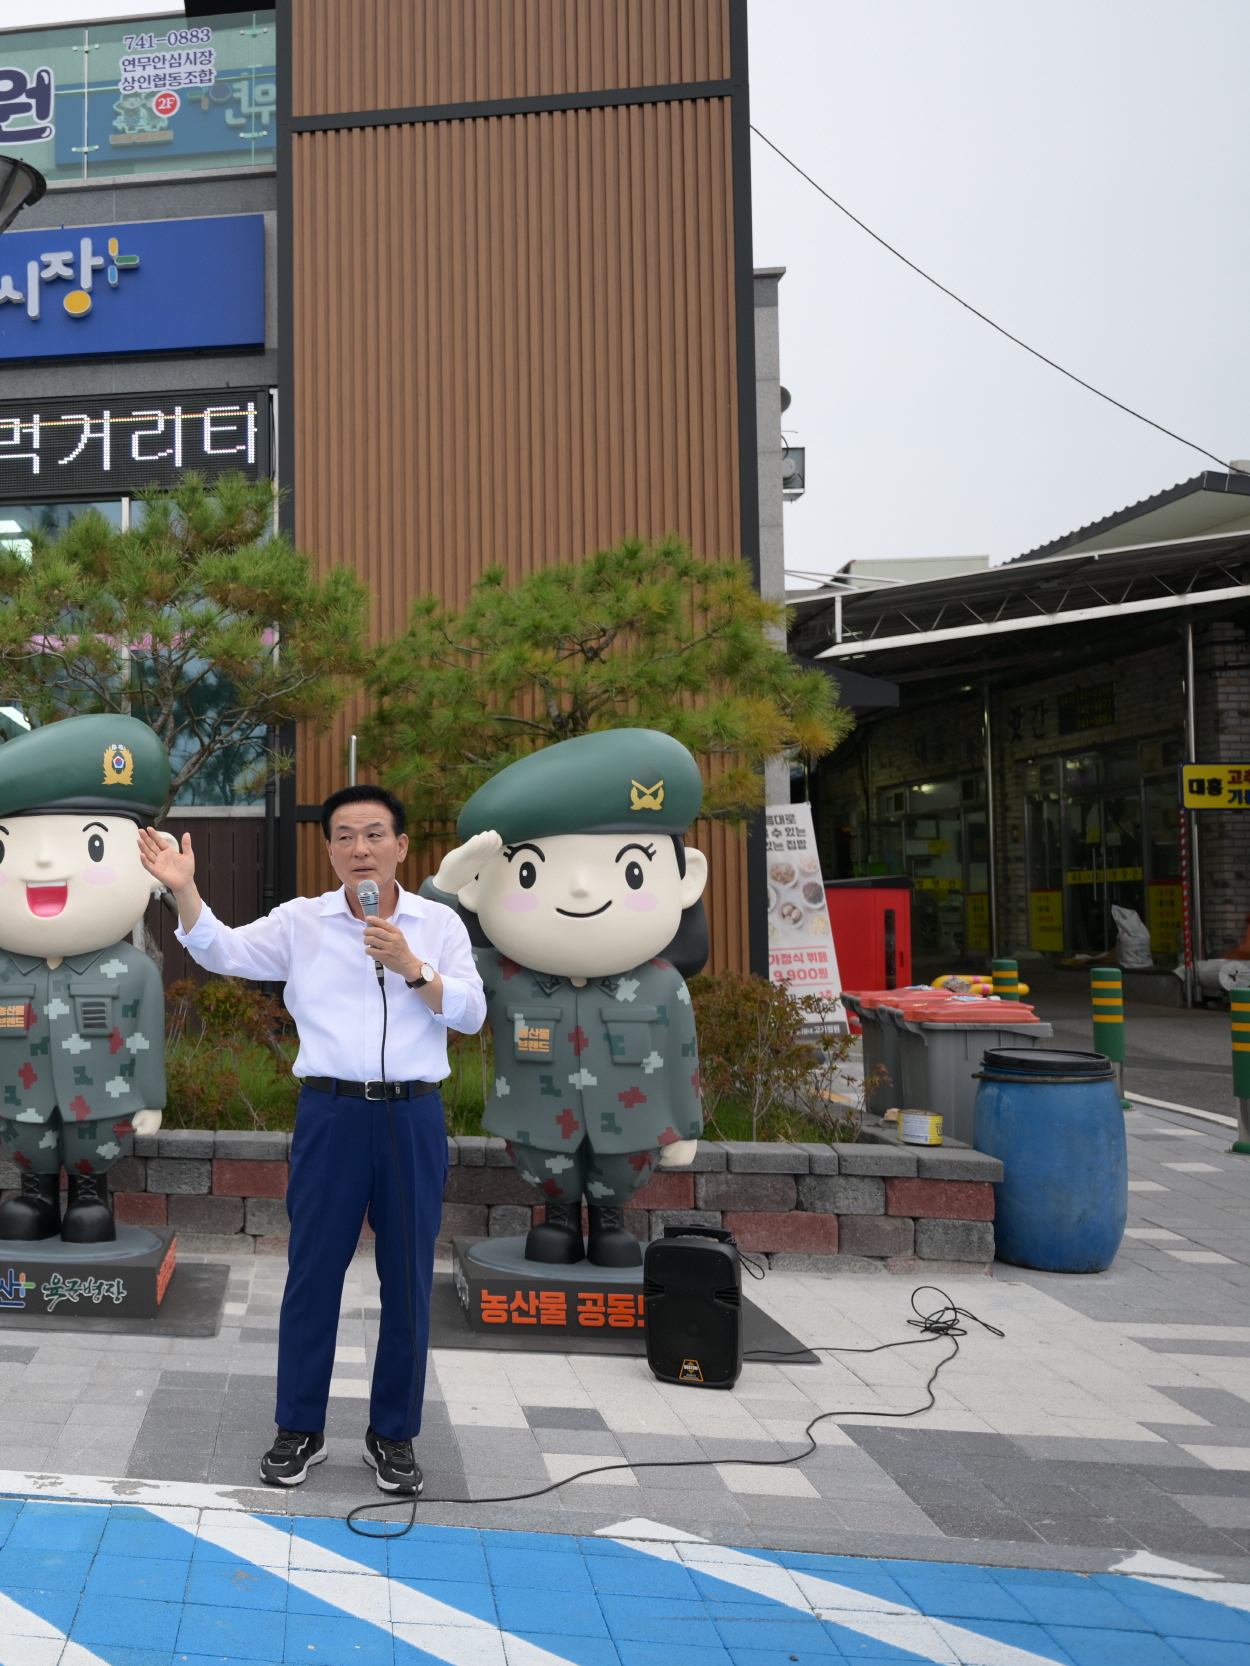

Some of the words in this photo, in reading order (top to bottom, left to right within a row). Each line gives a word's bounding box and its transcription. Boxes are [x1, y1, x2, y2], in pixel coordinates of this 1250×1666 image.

[124, 28, 211, 51] 741-0883
[122, 50, 214, 73] 연무안심시장
[121, 69, 214, 92] 상인협동조합
[157, 97, 176, 110] 2F
[771, 828, 782, 839] 수
[785, 827, 807, 838] 있는
[768, 953, 805, 966] 가정식
[773, 967, 829, 982] 9900원
[517, 1040, 550, 1053] 브랜드
[41, 1272, 128, 1312] 육군병장
[480, 1289, 568, 1326] 농산물
